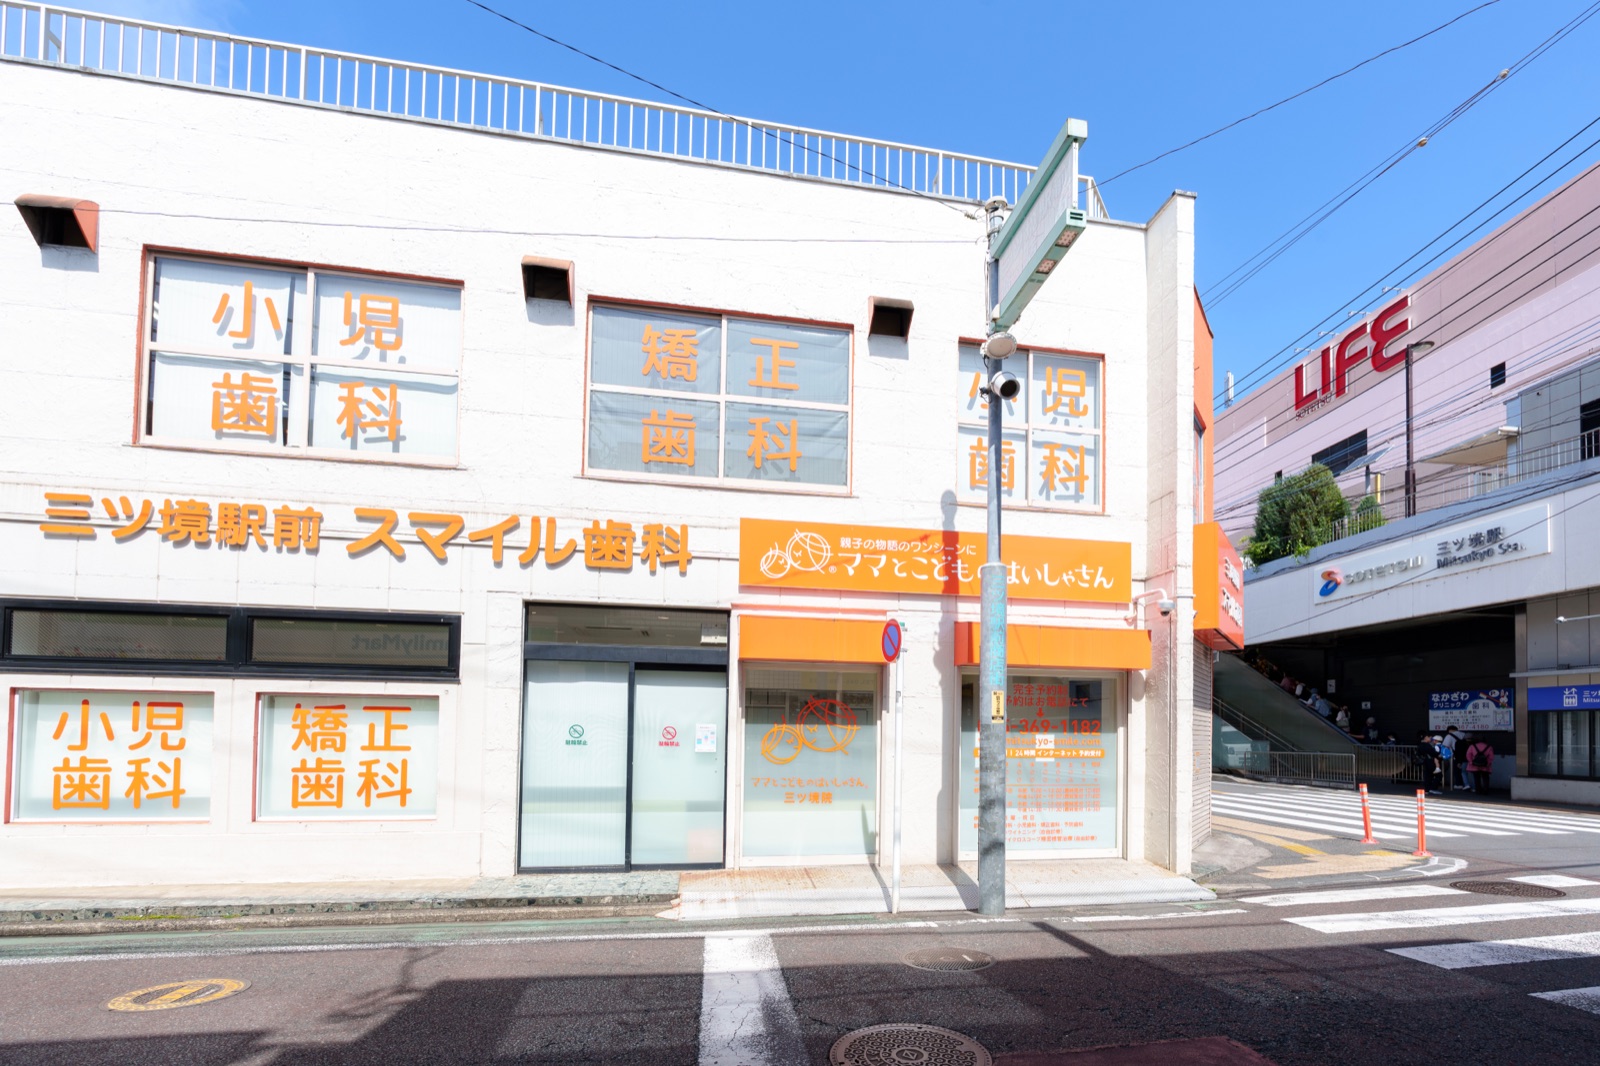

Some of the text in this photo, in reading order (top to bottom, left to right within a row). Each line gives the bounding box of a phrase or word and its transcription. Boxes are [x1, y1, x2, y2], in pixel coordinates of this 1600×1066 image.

[212, 280, 403, 352] 小児
[641, 324, 800, 391] 矯正
[1294, 295, 1412, 411] LIFE
[211, 372, 403, 442] 歯科
[641, 409, 803, 472] 歯科
[969, 437, 1090, 494] 歯科
[39, 491, 694, 575] 三ツ境駅前 スマイル歯科
[839, 536, 977, 556] 親子の物語のワンシーンに
[1436, 527, 1505, 557] 三ツ境駅
[1436, 541, 1527, 570] Mitsukyo Sta.
[1343, 555, 1423, 585] SOTETSU
[1013, 684, 1069, 695] 完全予約制
[1431, 691, 1470, 702] なかざわ
[52, 700, 187, 753] 小児
[291, 703, 412, 753] 矯正
[52, 757, 187, 809] 歯科
[291, 757, 413, 809] 歯科
[784, 791, 833, 804] 三ツ境院
